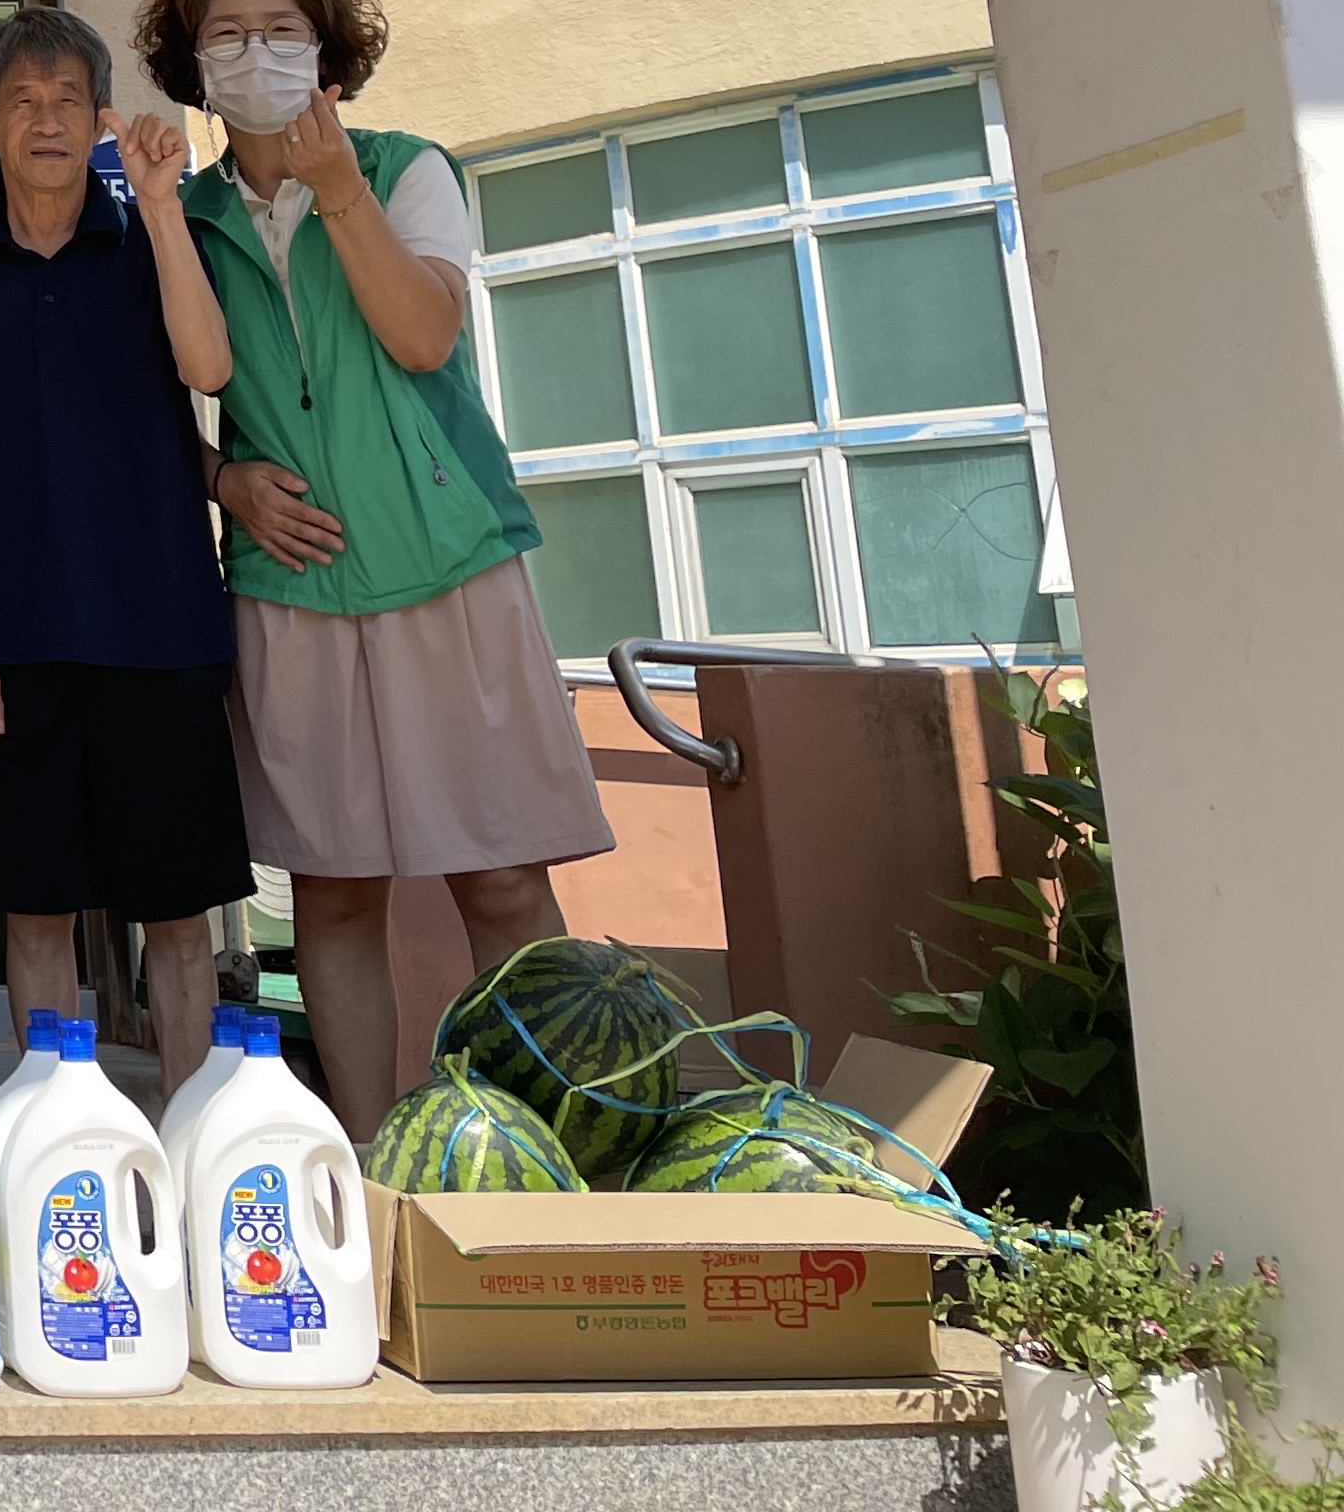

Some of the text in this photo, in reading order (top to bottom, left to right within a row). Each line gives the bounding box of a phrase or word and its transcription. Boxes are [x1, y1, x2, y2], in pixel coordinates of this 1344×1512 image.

[51, 1211, 100, 1251] 퐁퐁
[233, 1204, 282, 1244] 퐁퐁
[480, 1274, 685, 1295] 대한민국 1호 명품인증 한돈
[704, 1274, 840, 1329] 포크밸리
